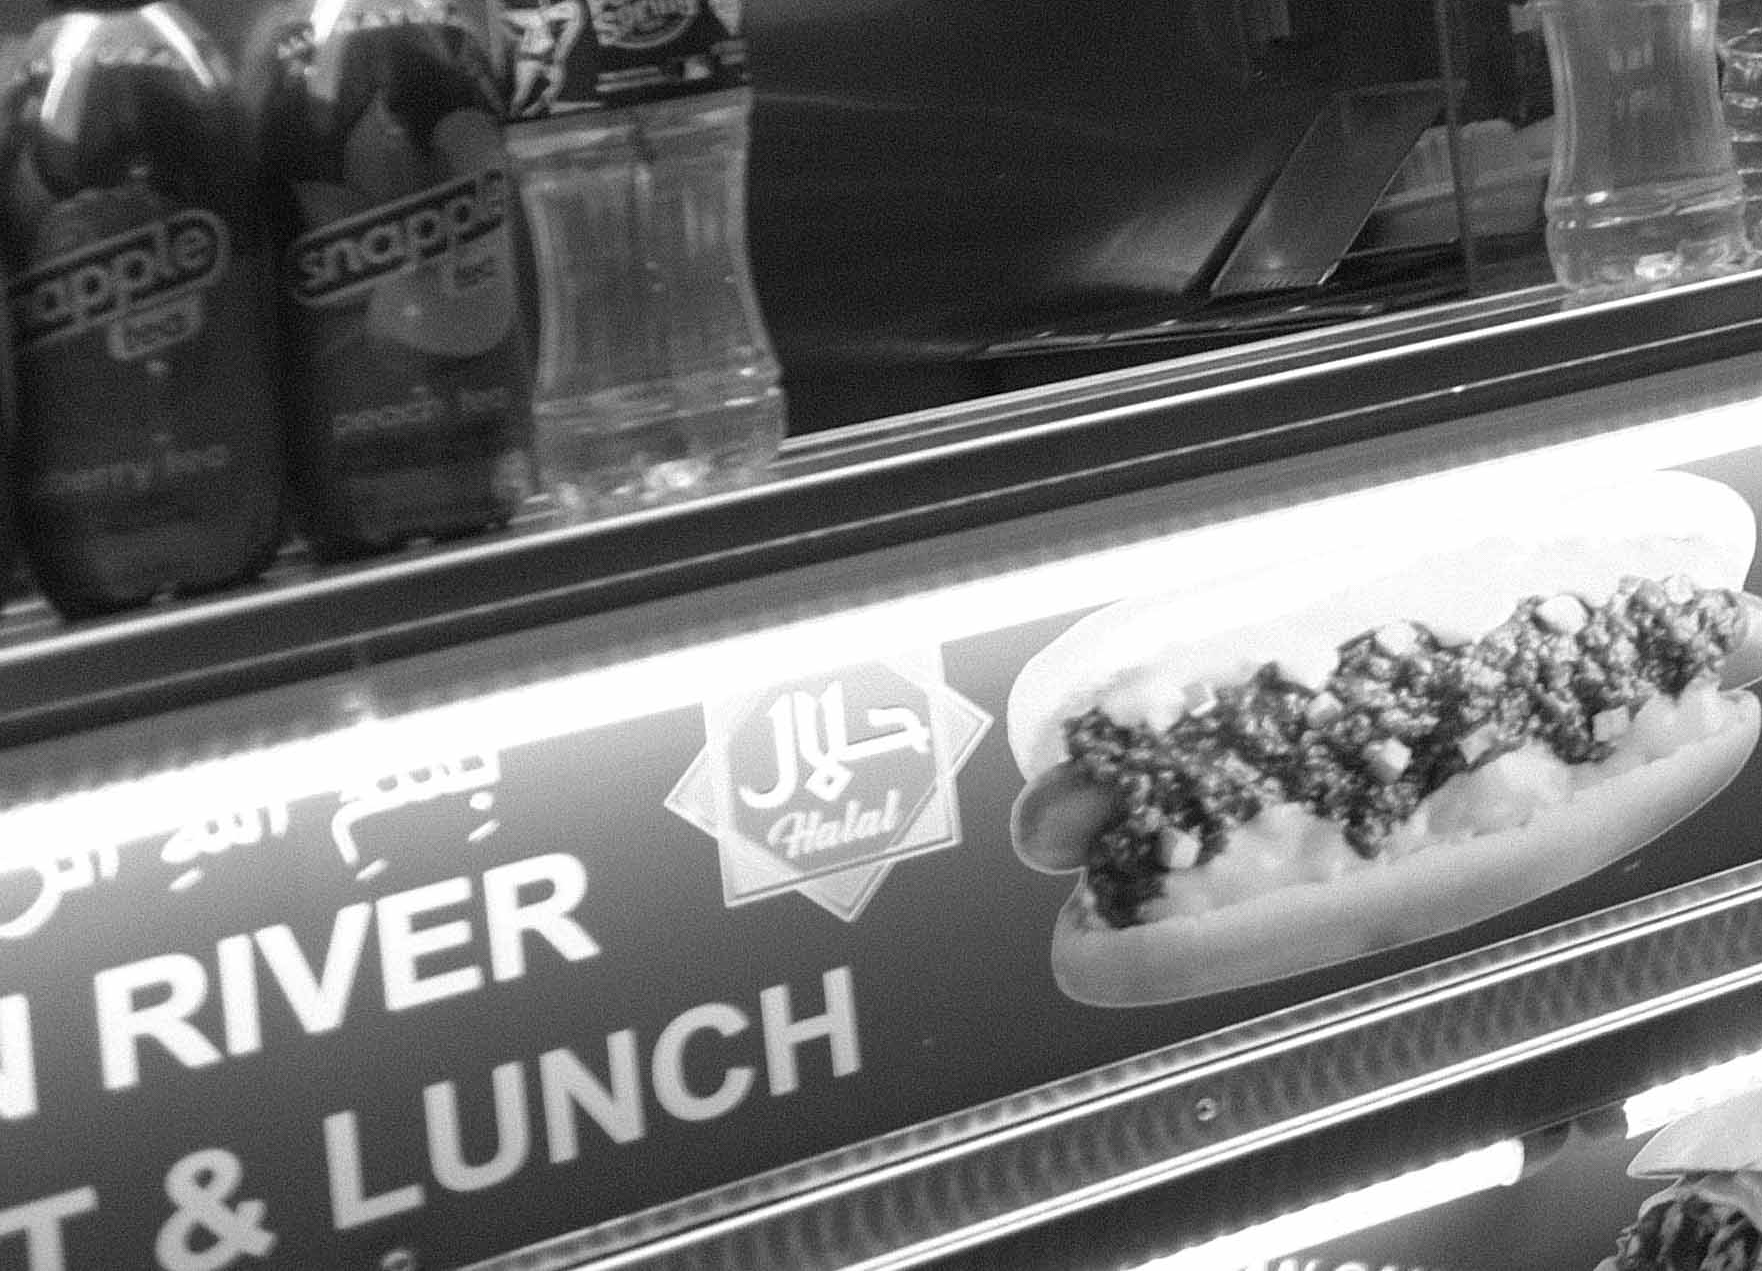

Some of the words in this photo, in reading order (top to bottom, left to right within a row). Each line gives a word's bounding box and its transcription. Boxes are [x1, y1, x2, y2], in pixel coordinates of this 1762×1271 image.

[739, 679, 930, 808] حلال
[768, 788, 900, 858] Halal
[93, 853, 600, 1090] RIVER
[155, 1148, 277, 1271] &
[323, 966, 862, 1230] LUNCH
